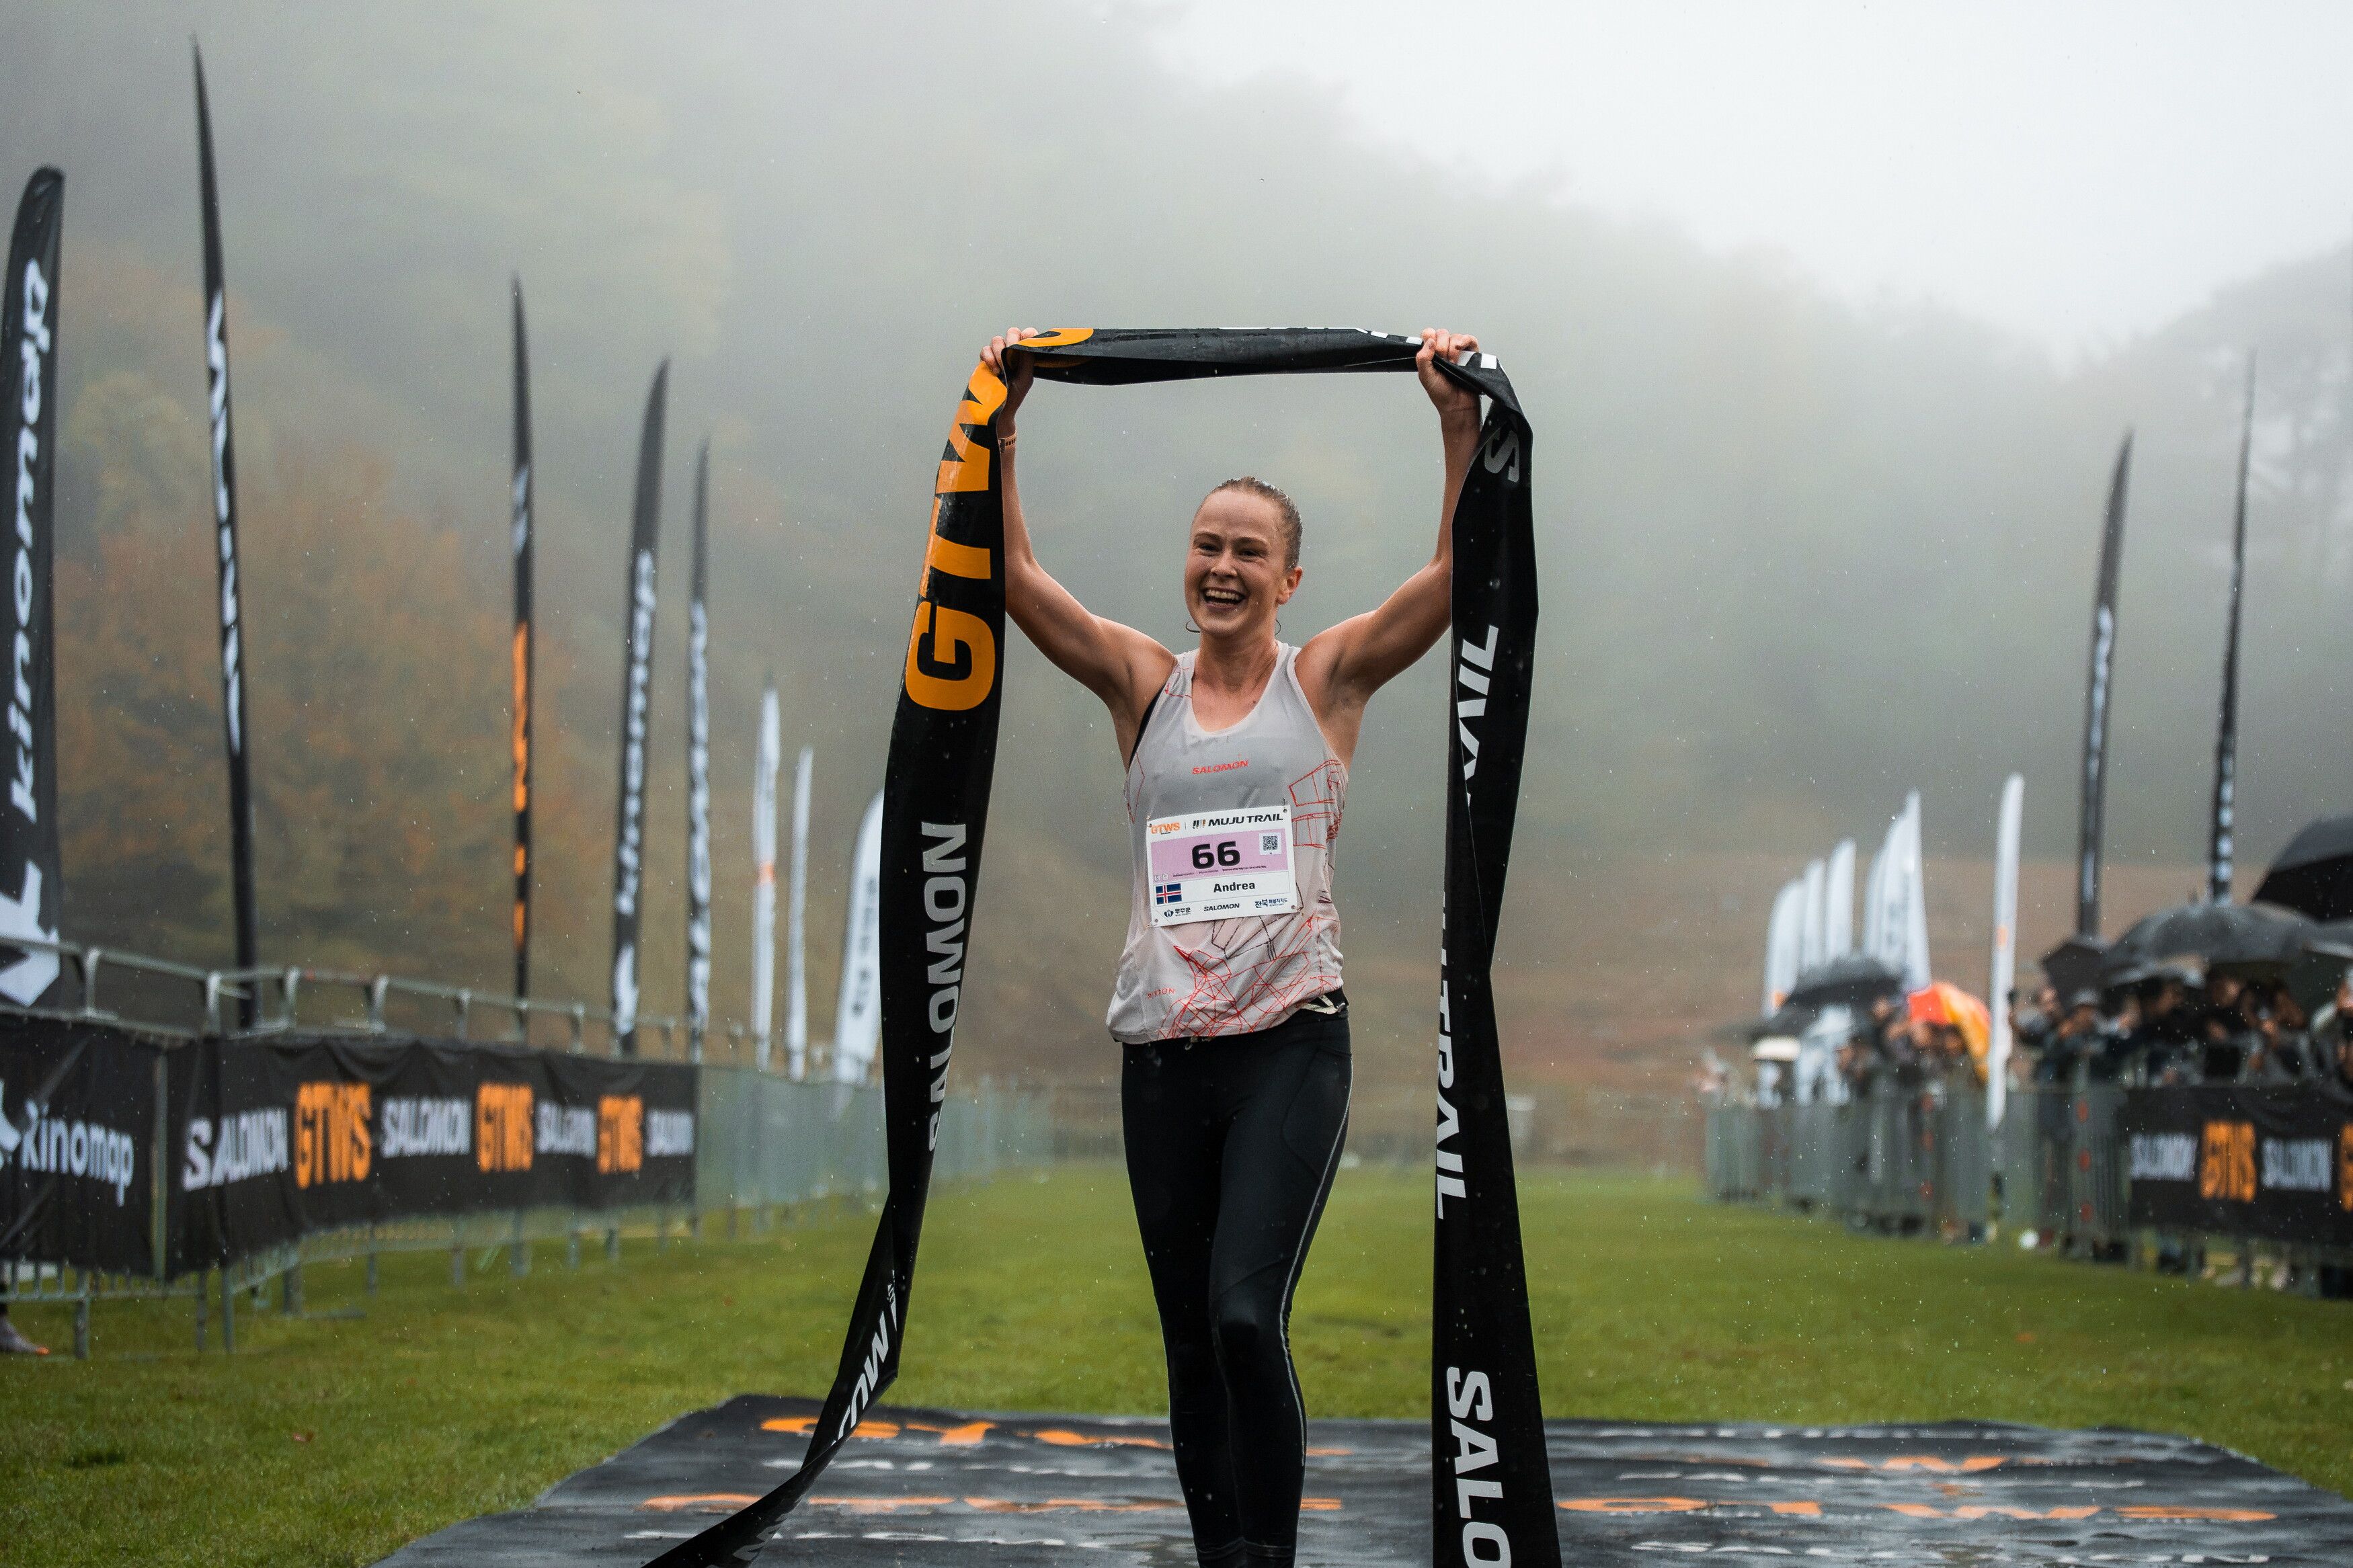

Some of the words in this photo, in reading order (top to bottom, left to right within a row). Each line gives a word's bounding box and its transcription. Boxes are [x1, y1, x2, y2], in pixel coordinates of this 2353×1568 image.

[1192, 759, 1248, 774] SALOMON
[1208, 815, 1244, 826] MUJU
[1246, 813, 1283, 823] TRAIL
[1150, 822, 1181, 835] GTWS
[1192, 841, 1241, 869] 66
[1213, 882, 1256, 893] Andrea
[1203, 903, 1240, 912] SALOMON
[182, 1108, 289, 1191] SALOMON
[295, 1081, 372, 1190] GTWS
[20, 1098, 134, 1207] kinomap
